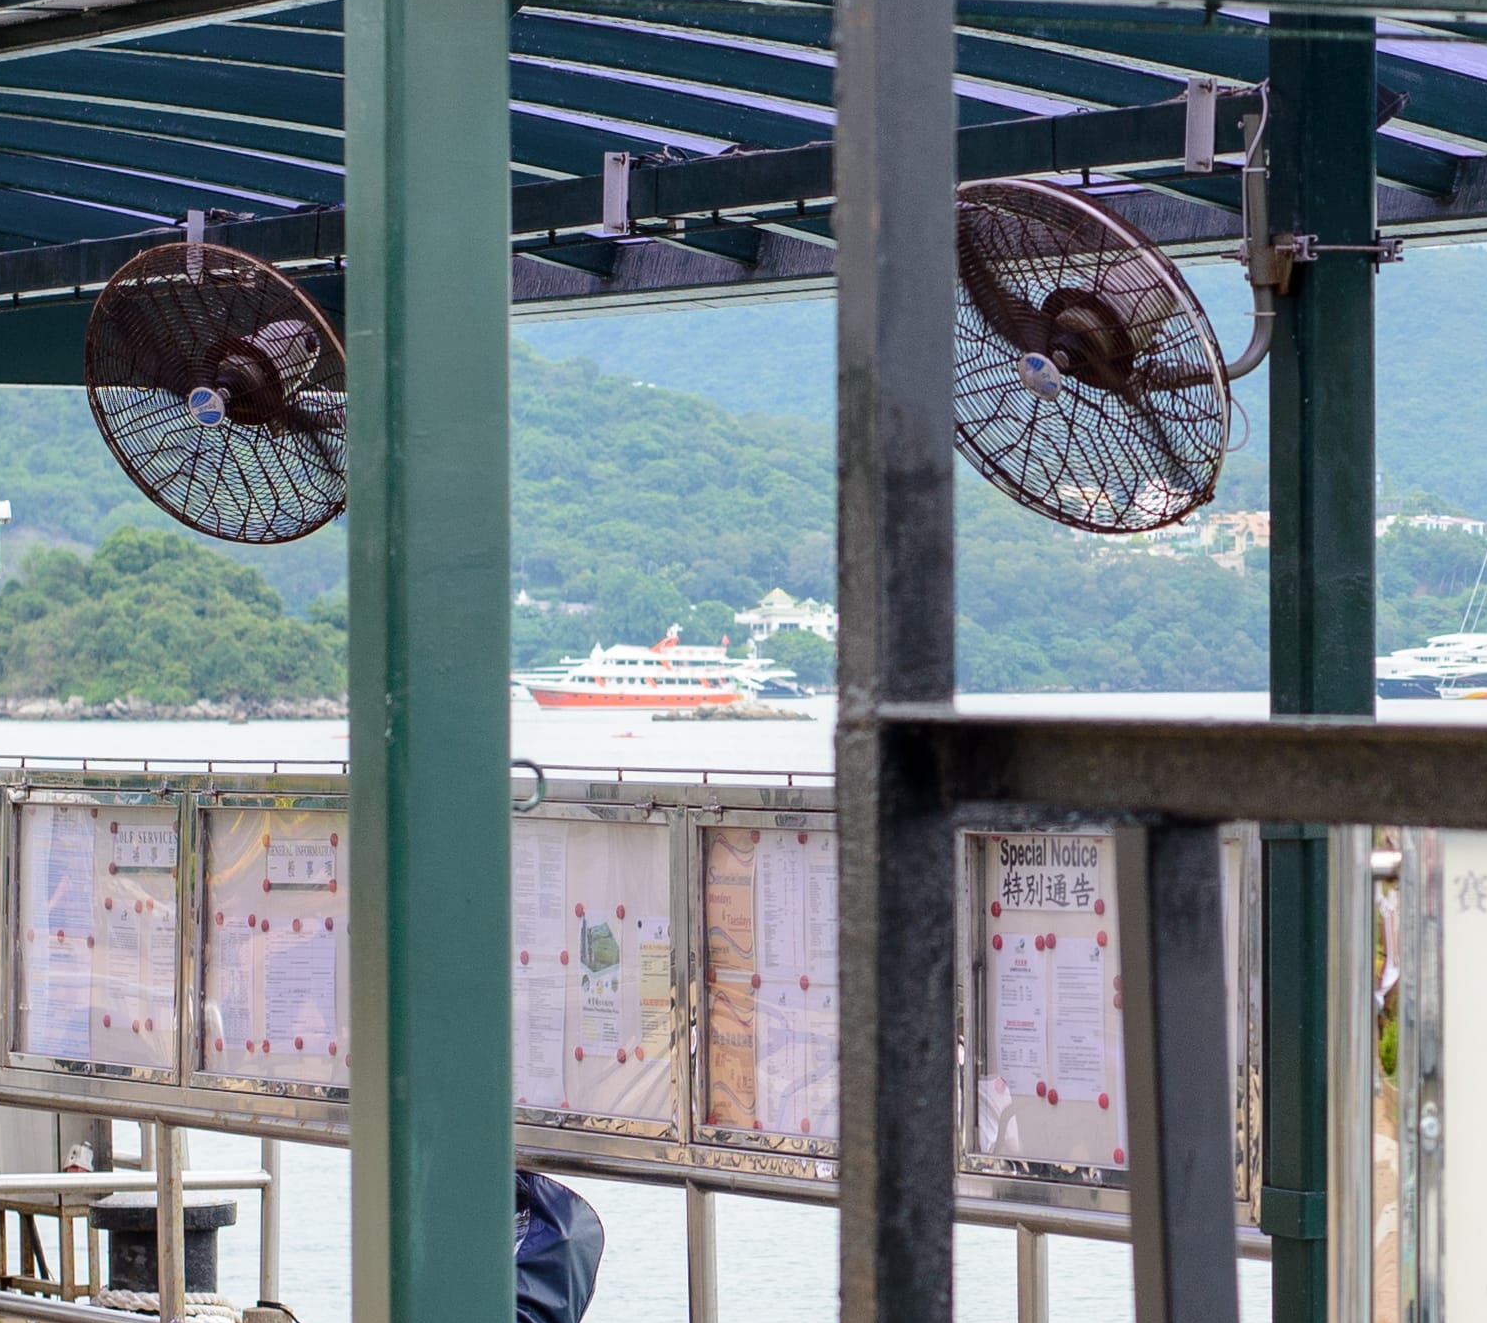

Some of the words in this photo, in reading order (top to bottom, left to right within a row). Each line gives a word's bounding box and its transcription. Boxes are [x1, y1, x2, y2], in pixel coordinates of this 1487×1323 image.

[1000, 838, 1047, 872] Special
[1051, 838, 1097, 868] Notice
[1002, 871, 1095, 907] 特別通告
